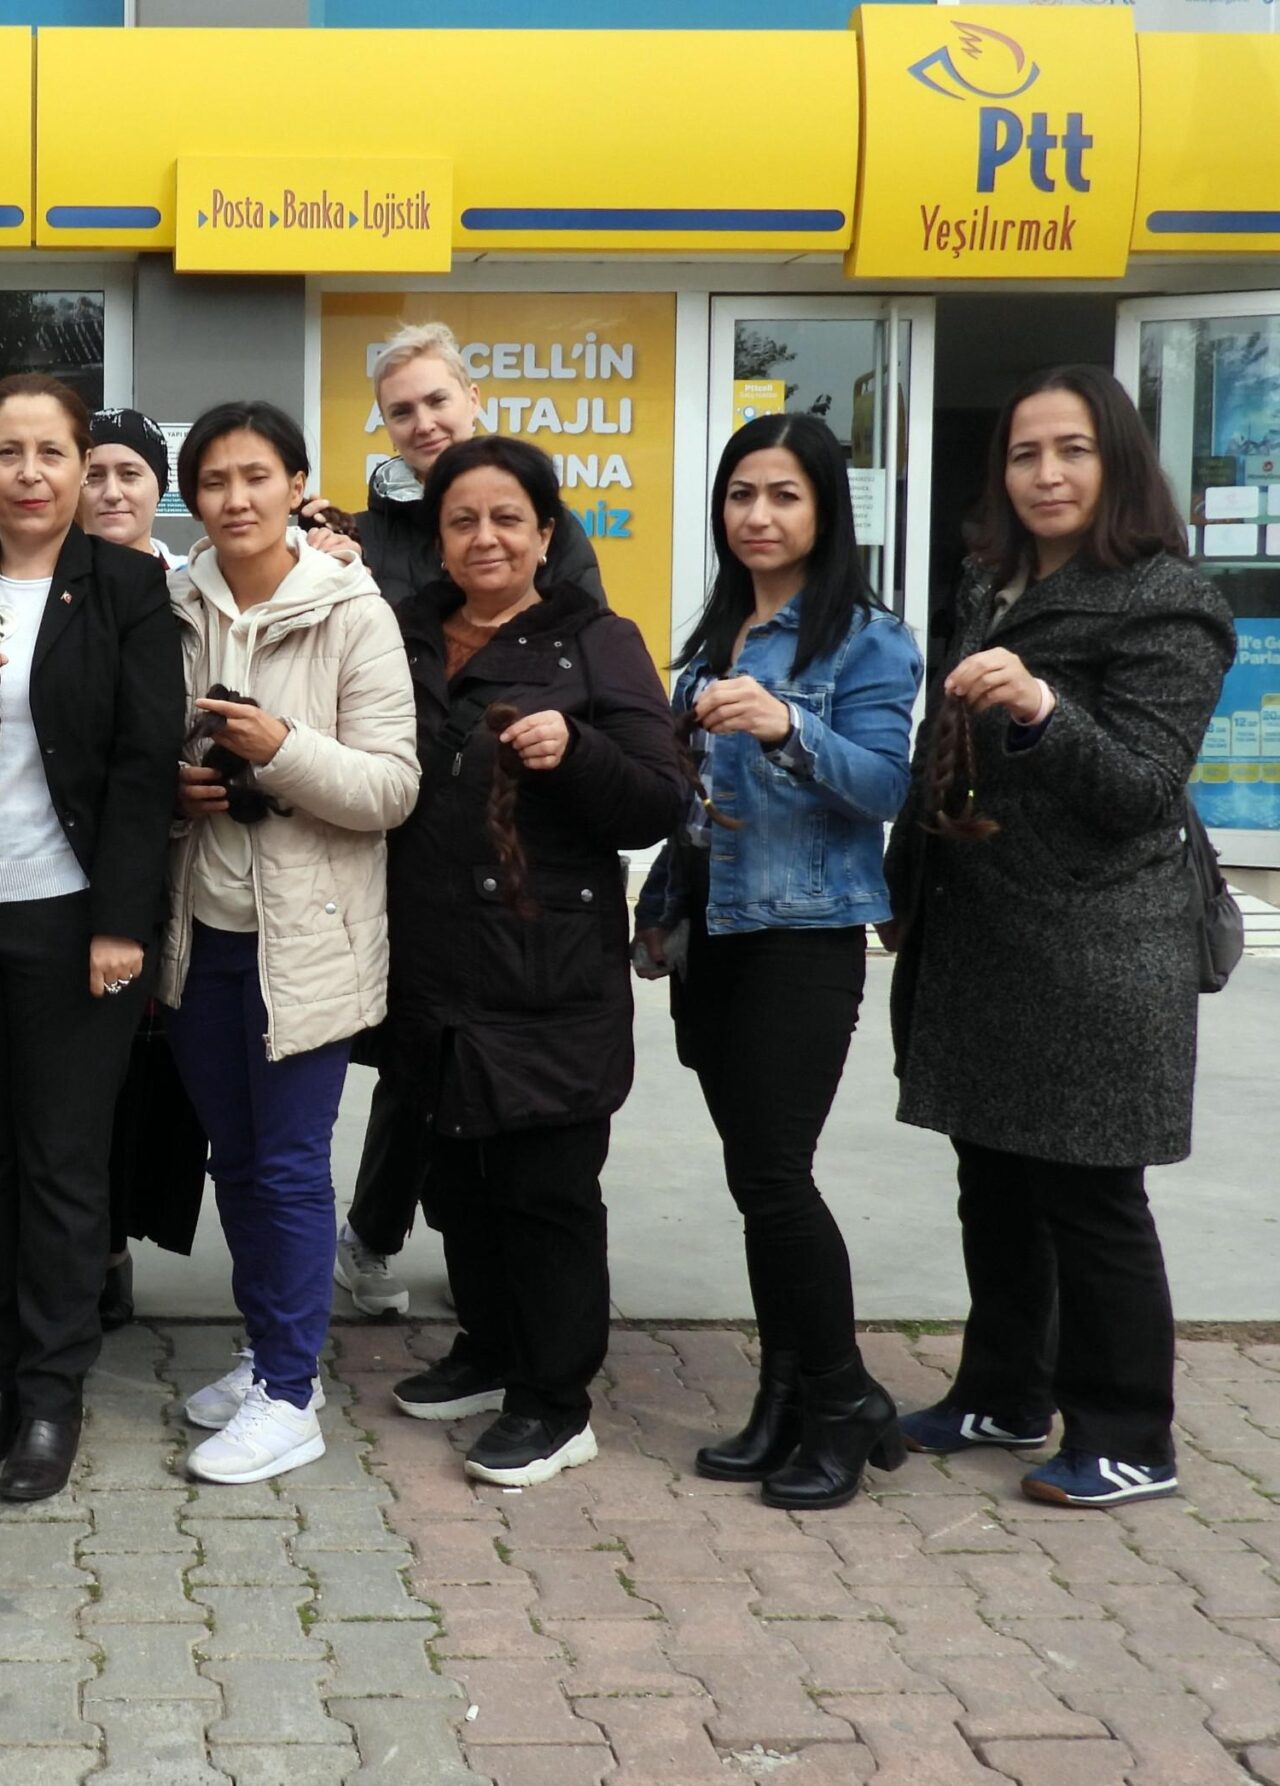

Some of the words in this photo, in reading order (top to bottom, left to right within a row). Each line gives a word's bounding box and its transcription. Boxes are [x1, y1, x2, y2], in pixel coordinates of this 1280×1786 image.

[976, 106, 1094, 193] Ptt
[211, 188, 263, 230] Posta
[283, 188, 344, 231] Banka
[363, 188, 431, 238] Lojistik
[920, 204, 1077, 259] Yeşilırmak
[366, 331, 634, 380] CELL'İN
[365, 397, 632, 434] ANTAJLI
